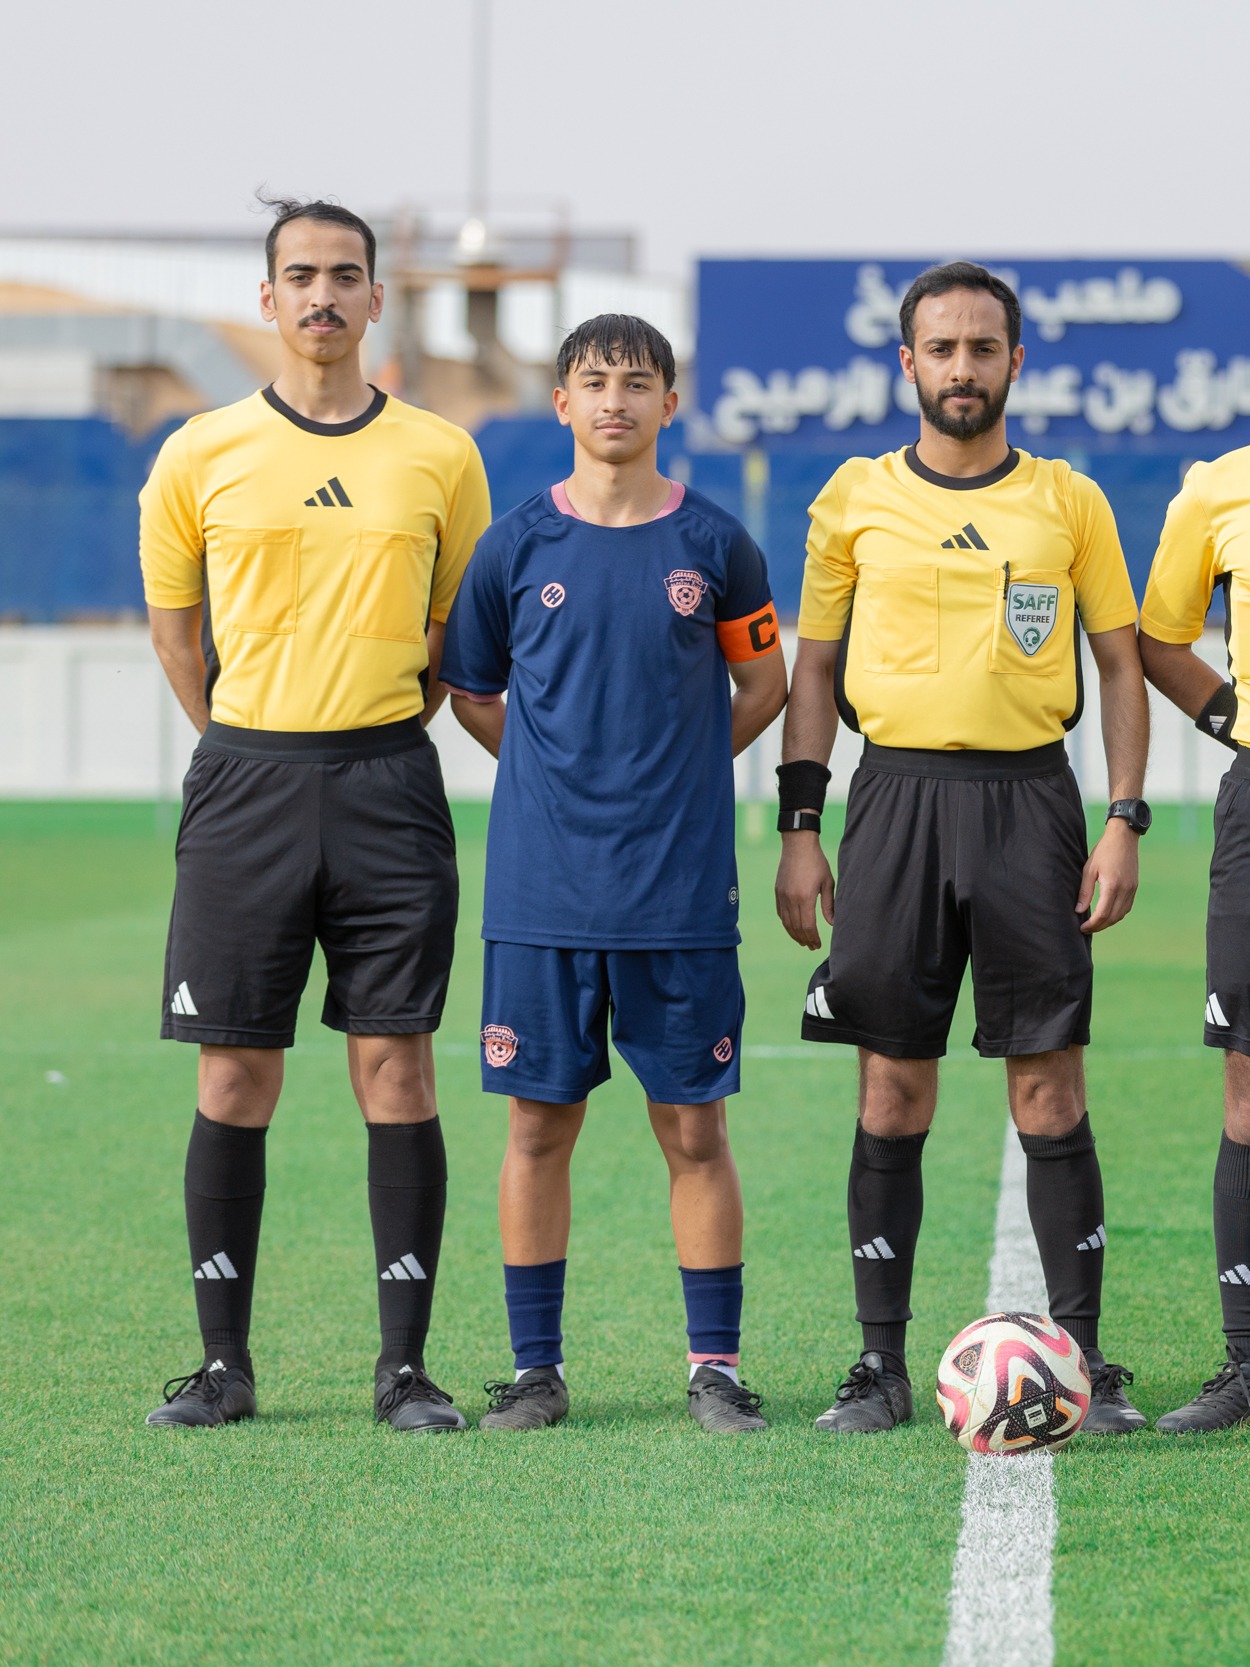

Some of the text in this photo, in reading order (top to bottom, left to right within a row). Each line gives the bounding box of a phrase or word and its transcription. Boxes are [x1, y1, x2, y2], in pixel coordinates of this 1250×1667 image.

[1022, 268, 1183, 343] ملعب
[1083, 361, 1156, 434] بن
[1012, 593, 1055, 610] SAFF
[1015, 614, 1050, 623] REFEREE
[748, 612, 776, 653] C
